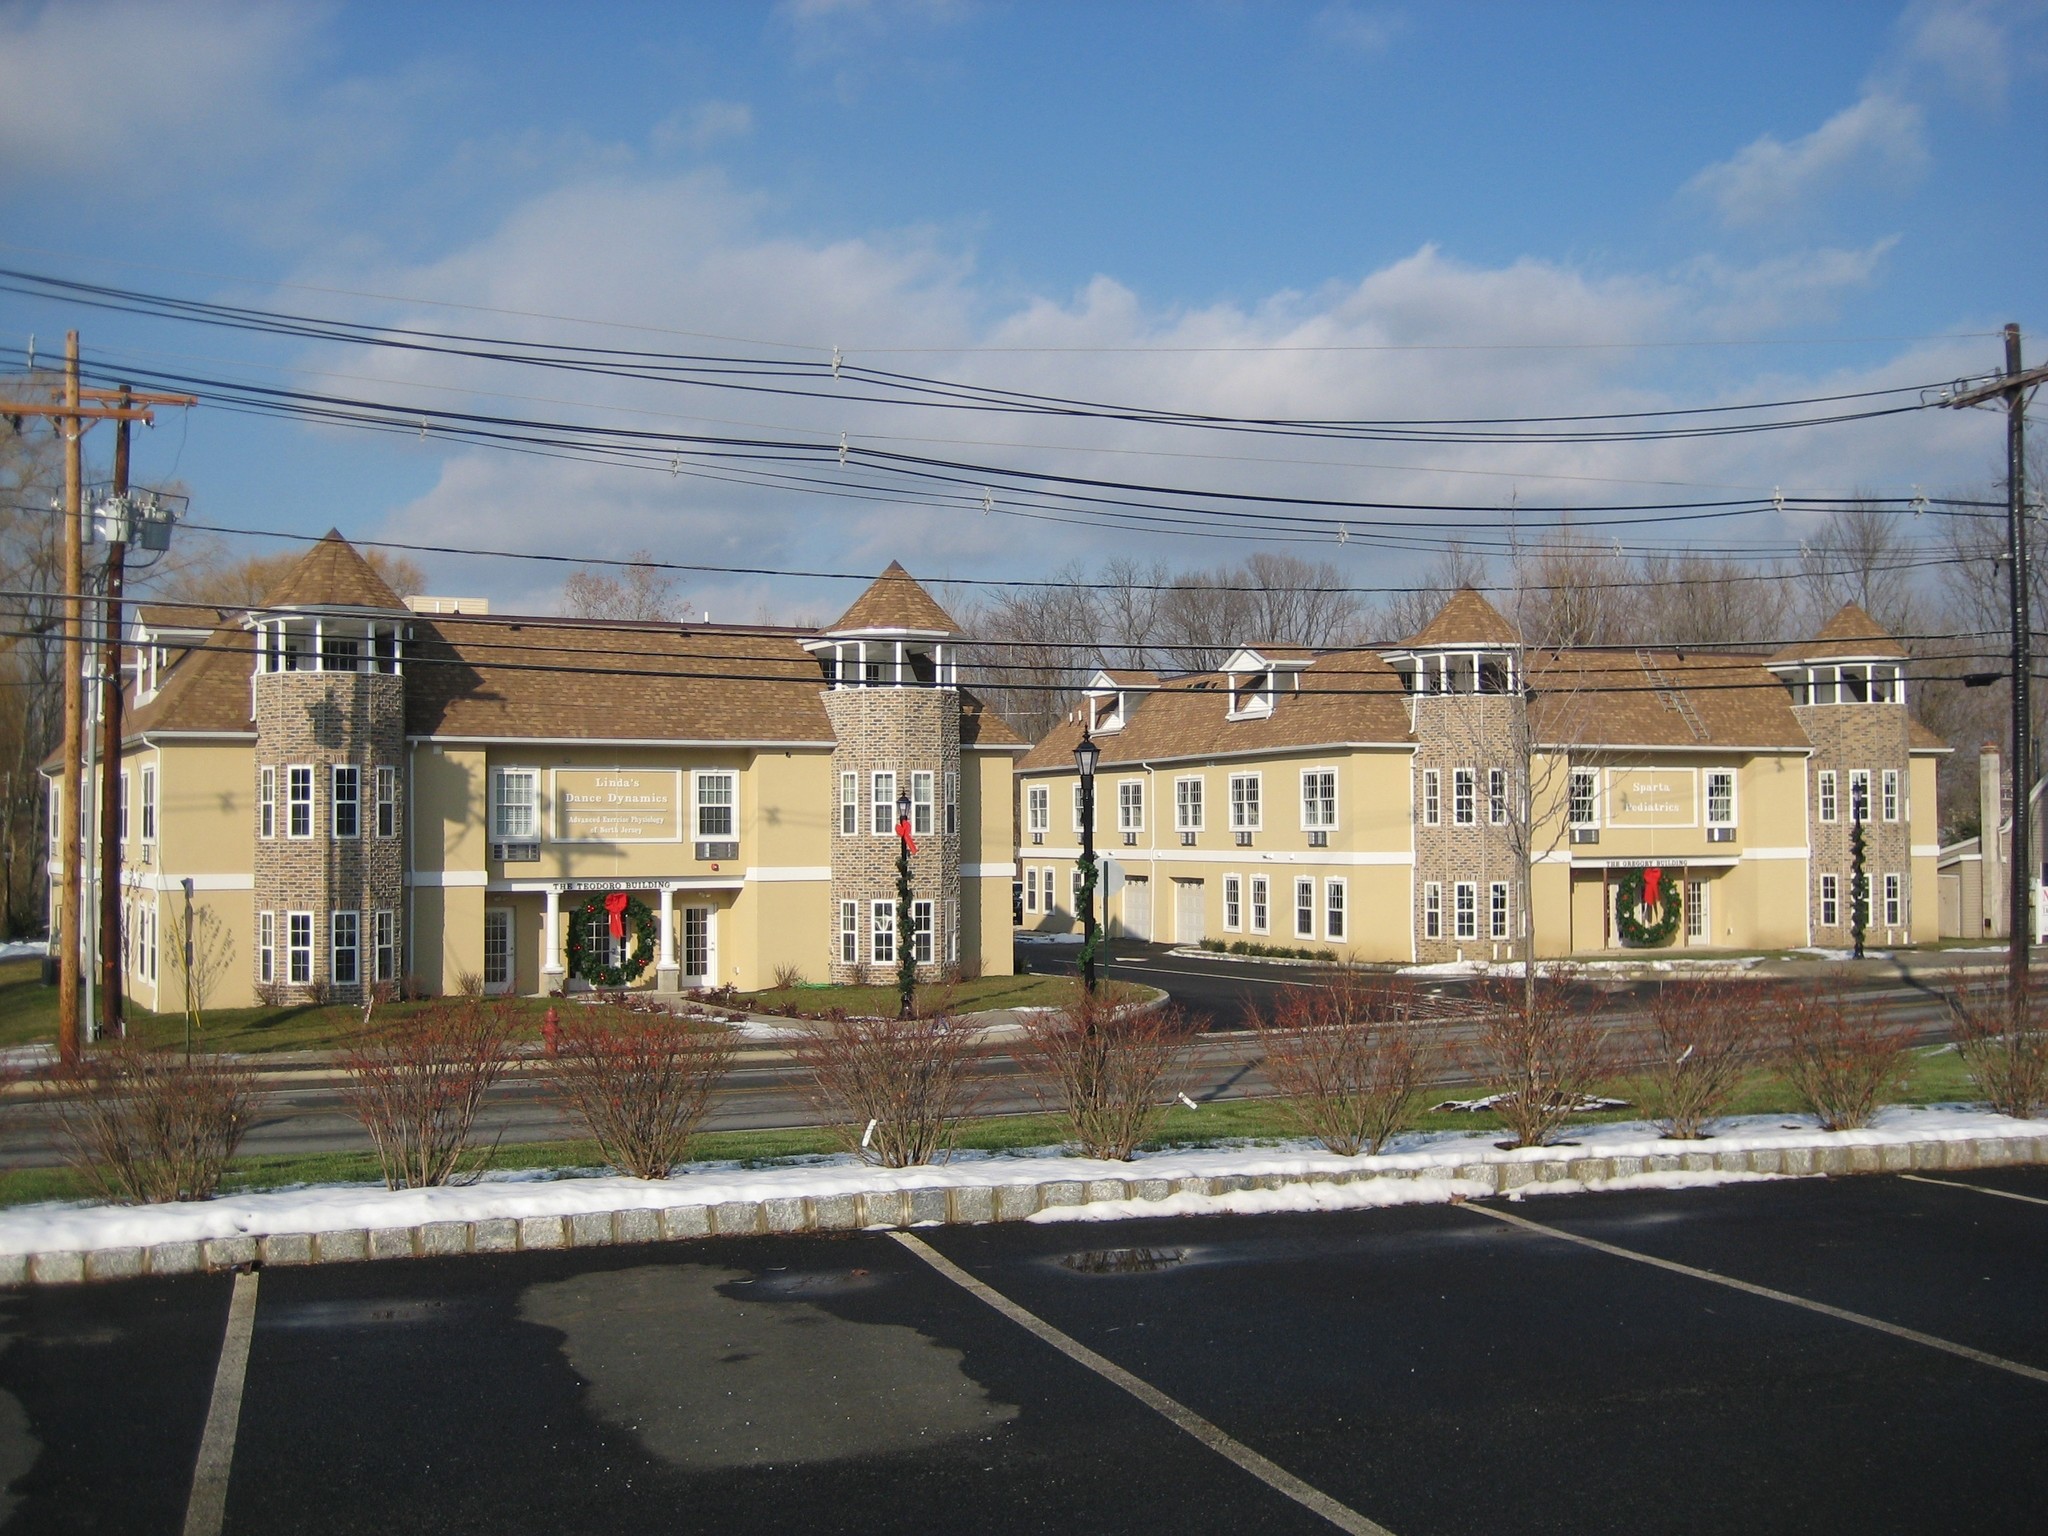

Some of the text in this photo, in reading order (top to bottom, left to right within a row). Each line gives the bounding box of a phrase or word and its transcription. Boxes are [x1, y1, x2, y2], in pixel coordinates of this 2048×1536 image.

[595, 778, 640, 787] Linda's
[1633, 783, 1670, 793] Sparta
[565, 793, 668, 805] Dance Dynamics
[1625, 802, 1679, 812] Pediatrics
[630, 816, 664, 824] Physiology
[590, 826, 598, 834] of
[621, 826, 642, 834] Jersey
[577, 882, 622, 890] TEODORO
